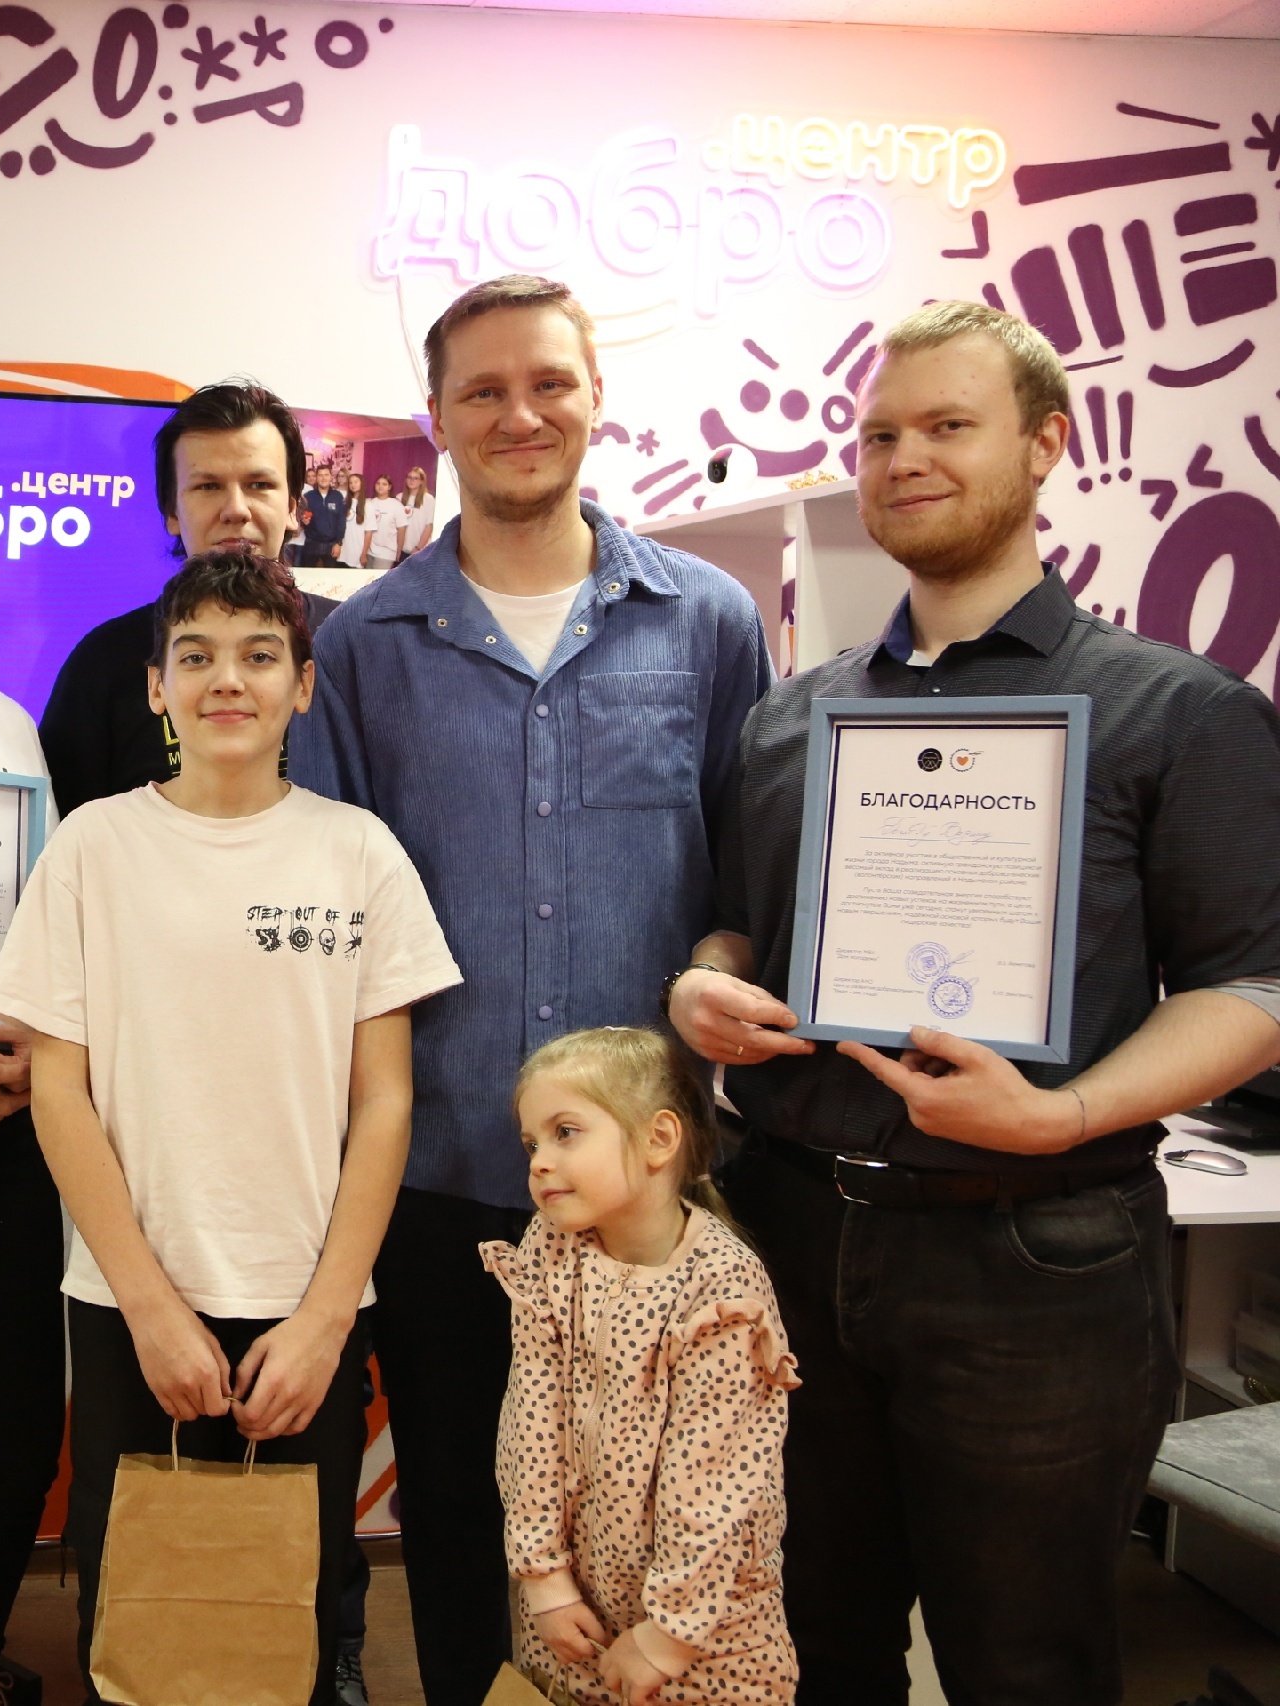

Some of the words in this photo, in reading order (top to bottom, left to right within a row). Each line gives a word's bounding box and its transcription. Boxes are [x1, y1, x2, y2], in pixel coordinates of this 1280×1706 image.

[11, 471, 135, 507] .центр
[860, 792, 1036, 811] БЛАГОДАРНОСТЬ
[245, 905, 284, 922] STEP
[294, 906, 321, 922] OUT
[325, 907, 341, 924] OF
